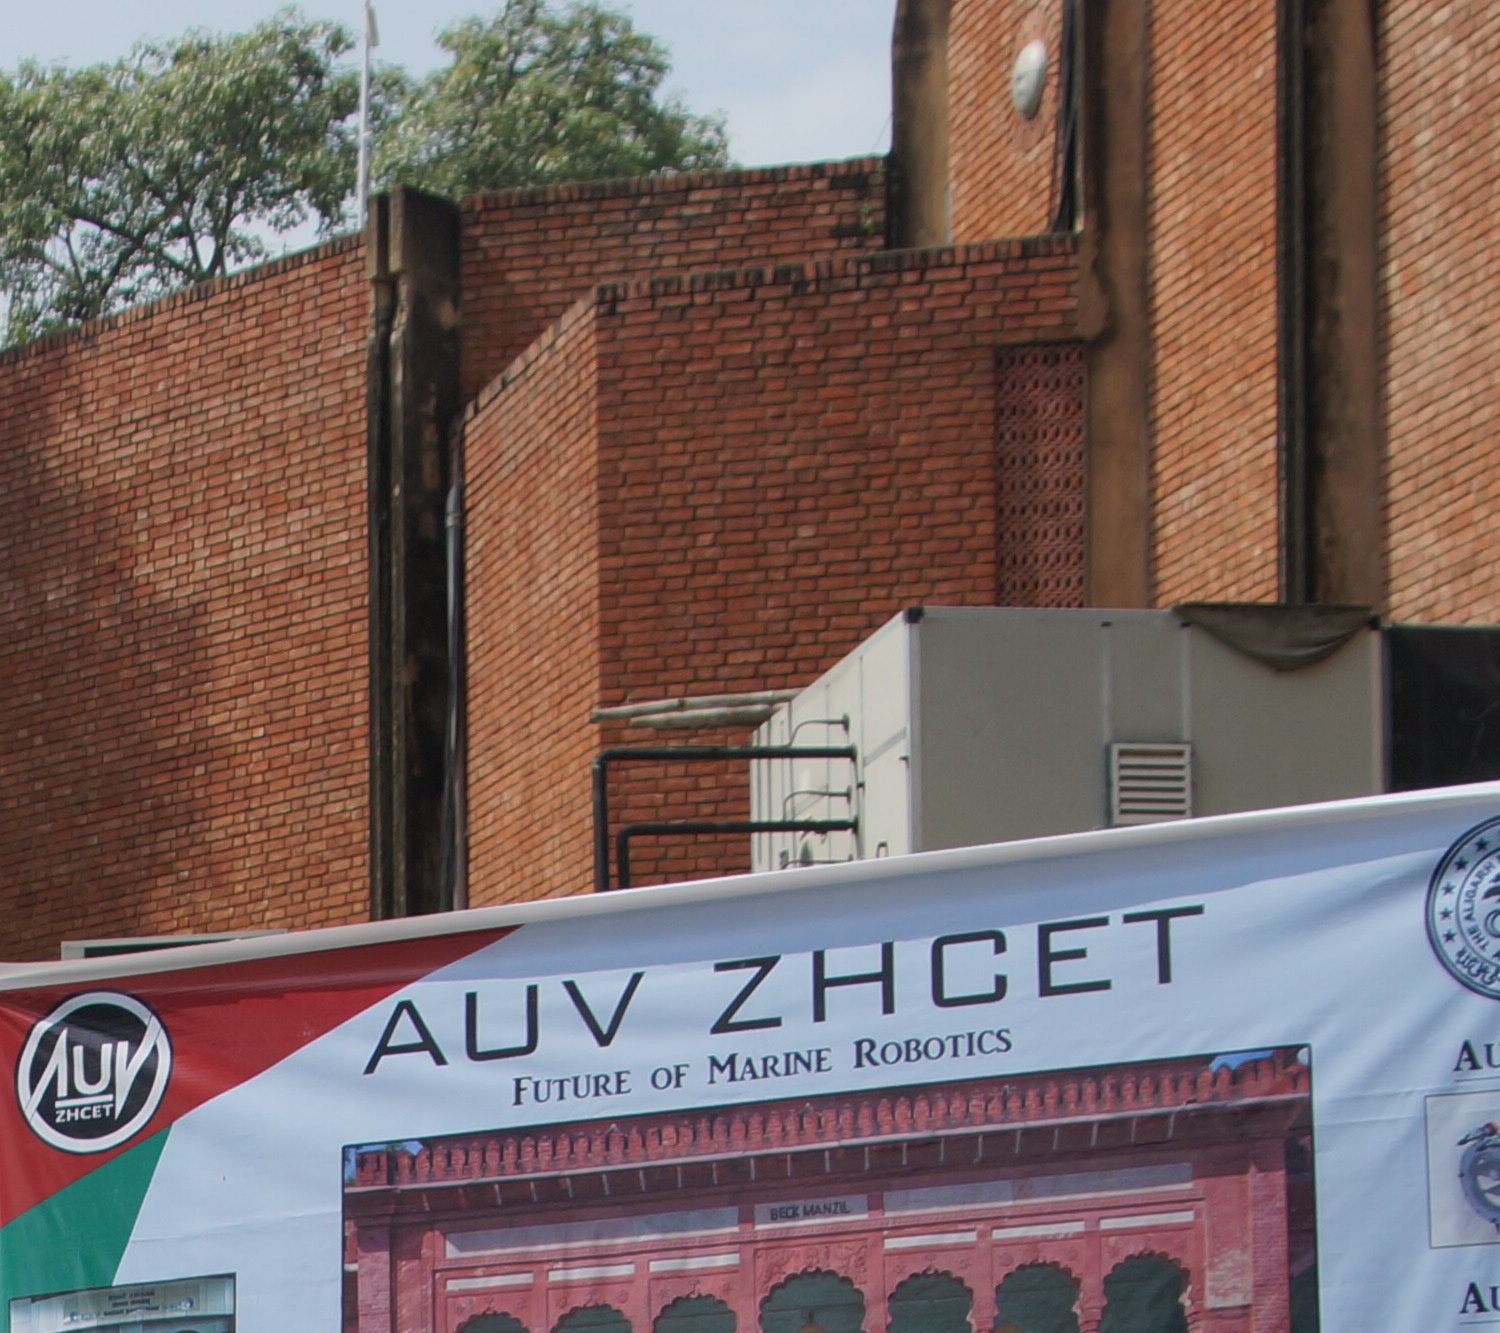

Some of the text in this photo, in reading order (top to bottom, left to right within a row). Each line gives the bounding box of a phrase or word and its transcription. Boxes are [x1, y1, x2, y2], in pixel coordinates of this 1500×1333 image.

[1463, 861, 1497, 922] ALIGARH
[363, 903, 1205, 1075] AUV ZHCET
[25, 1013, 161, 1122] AUV
[55, 1103, 114, 1124] ZHCET
[770, 1200, 851, 1221] BECK MANZIL
